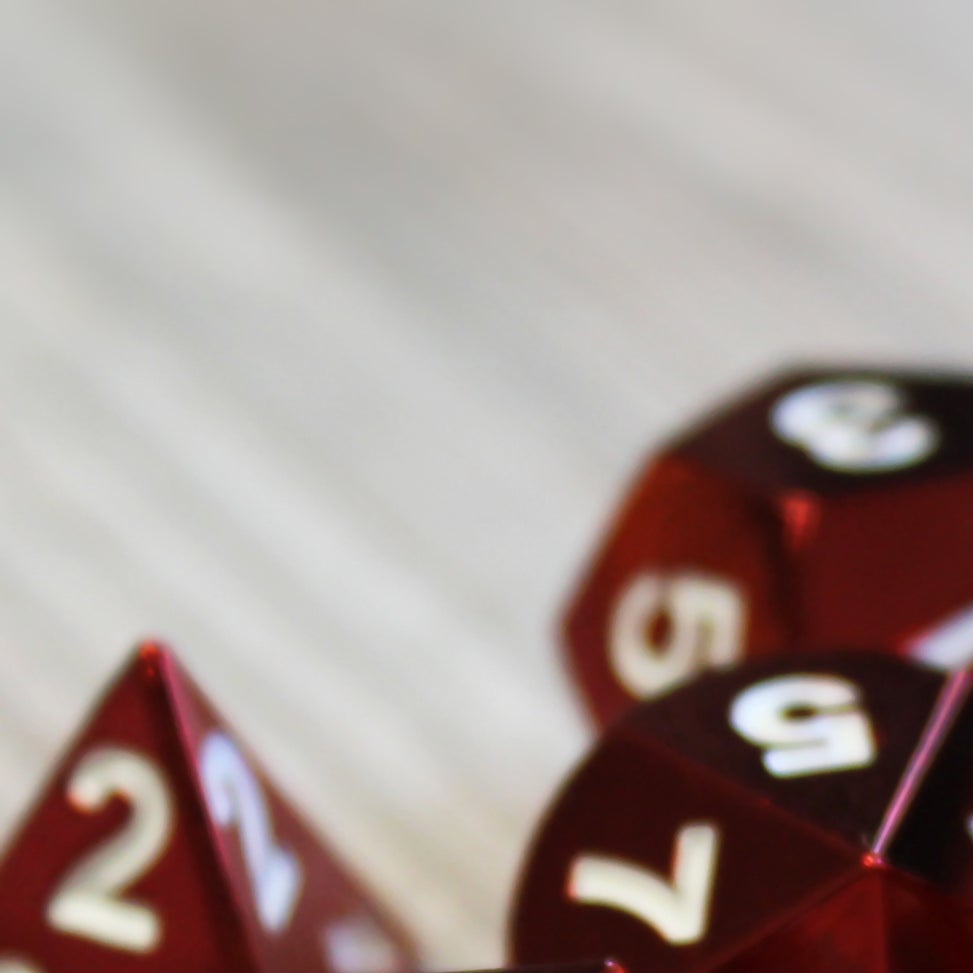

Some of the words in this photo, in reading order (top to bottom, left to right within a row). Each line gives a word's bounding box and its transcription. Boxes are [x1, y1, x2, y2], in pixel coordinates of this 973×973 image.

[730, 674, 876, 778] 5
[48, 748, 173, 952] 2
[569, 824, 718, 945] 7
